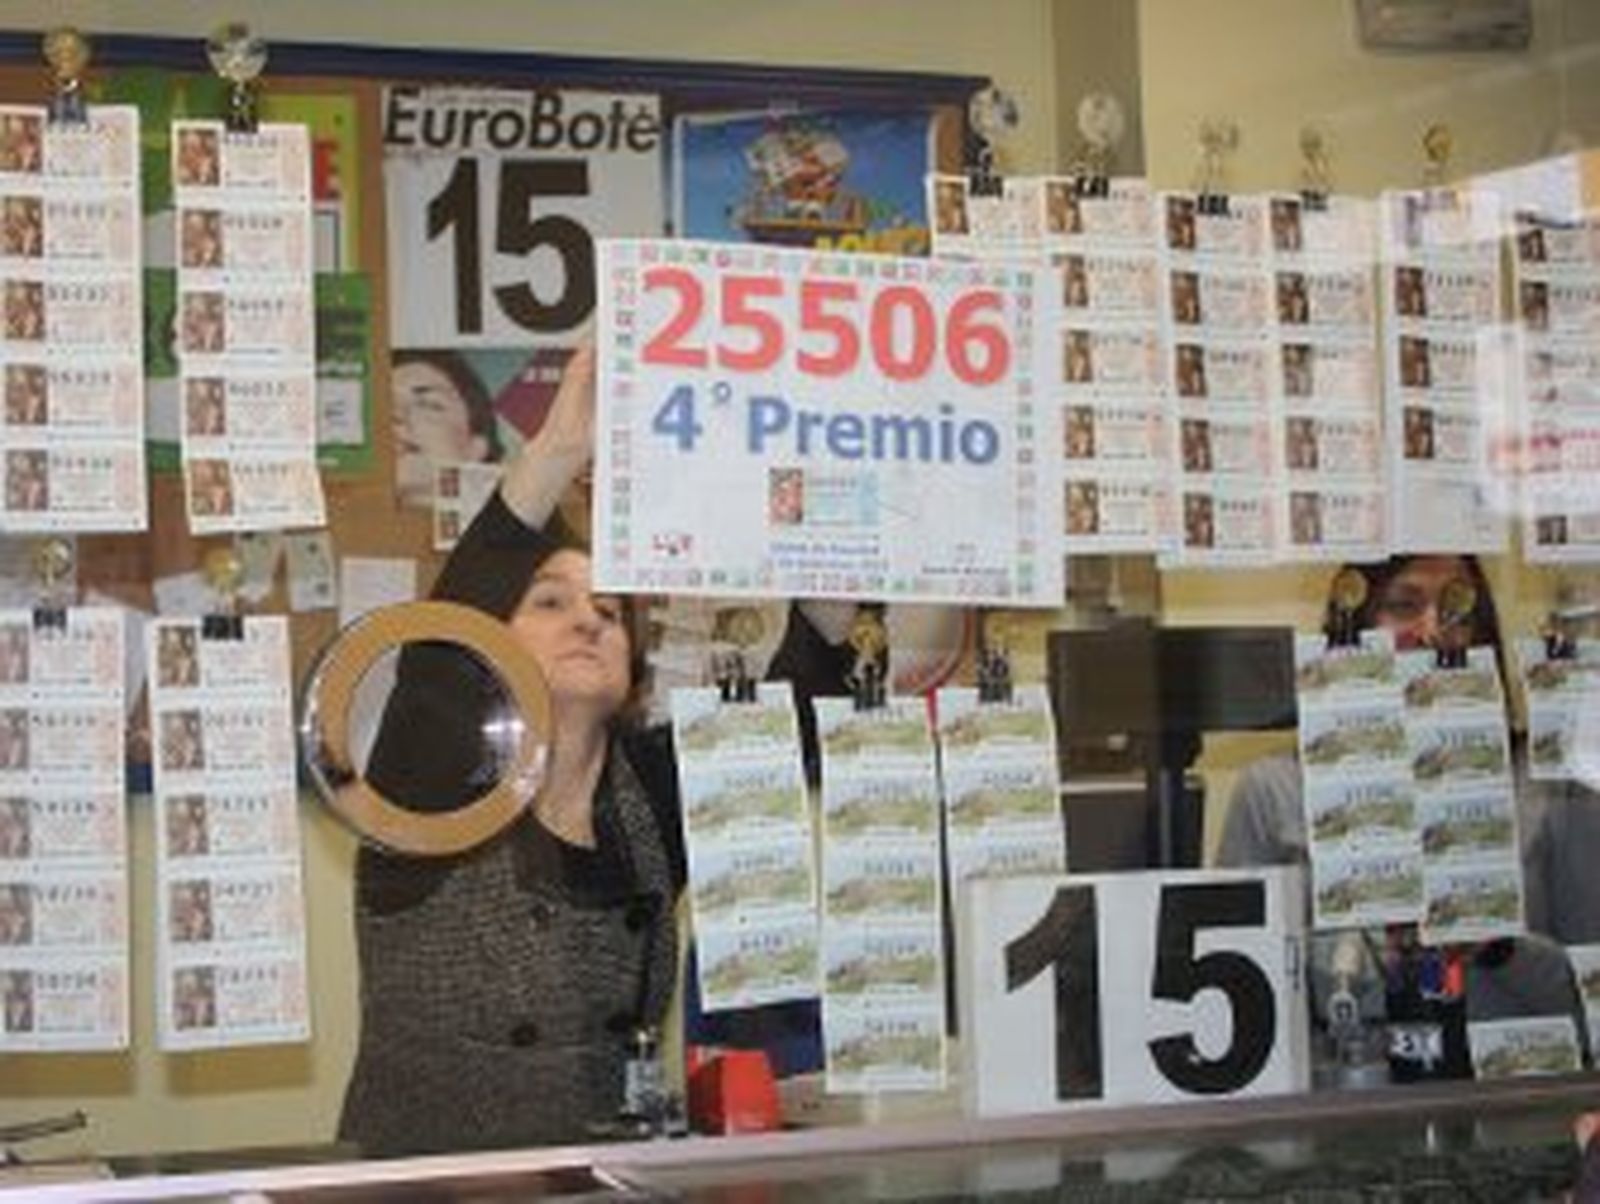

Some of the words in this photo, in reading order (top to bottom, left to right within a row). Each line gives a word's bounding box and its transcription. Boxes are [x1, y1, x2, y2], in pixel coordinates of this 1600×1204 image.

[426, 158, 597, 335] 15
[640, 267, 1011, 386] 25506
[747, 396, 1001, 466] Premio
[1003, 880, 1277, 1102] 15
